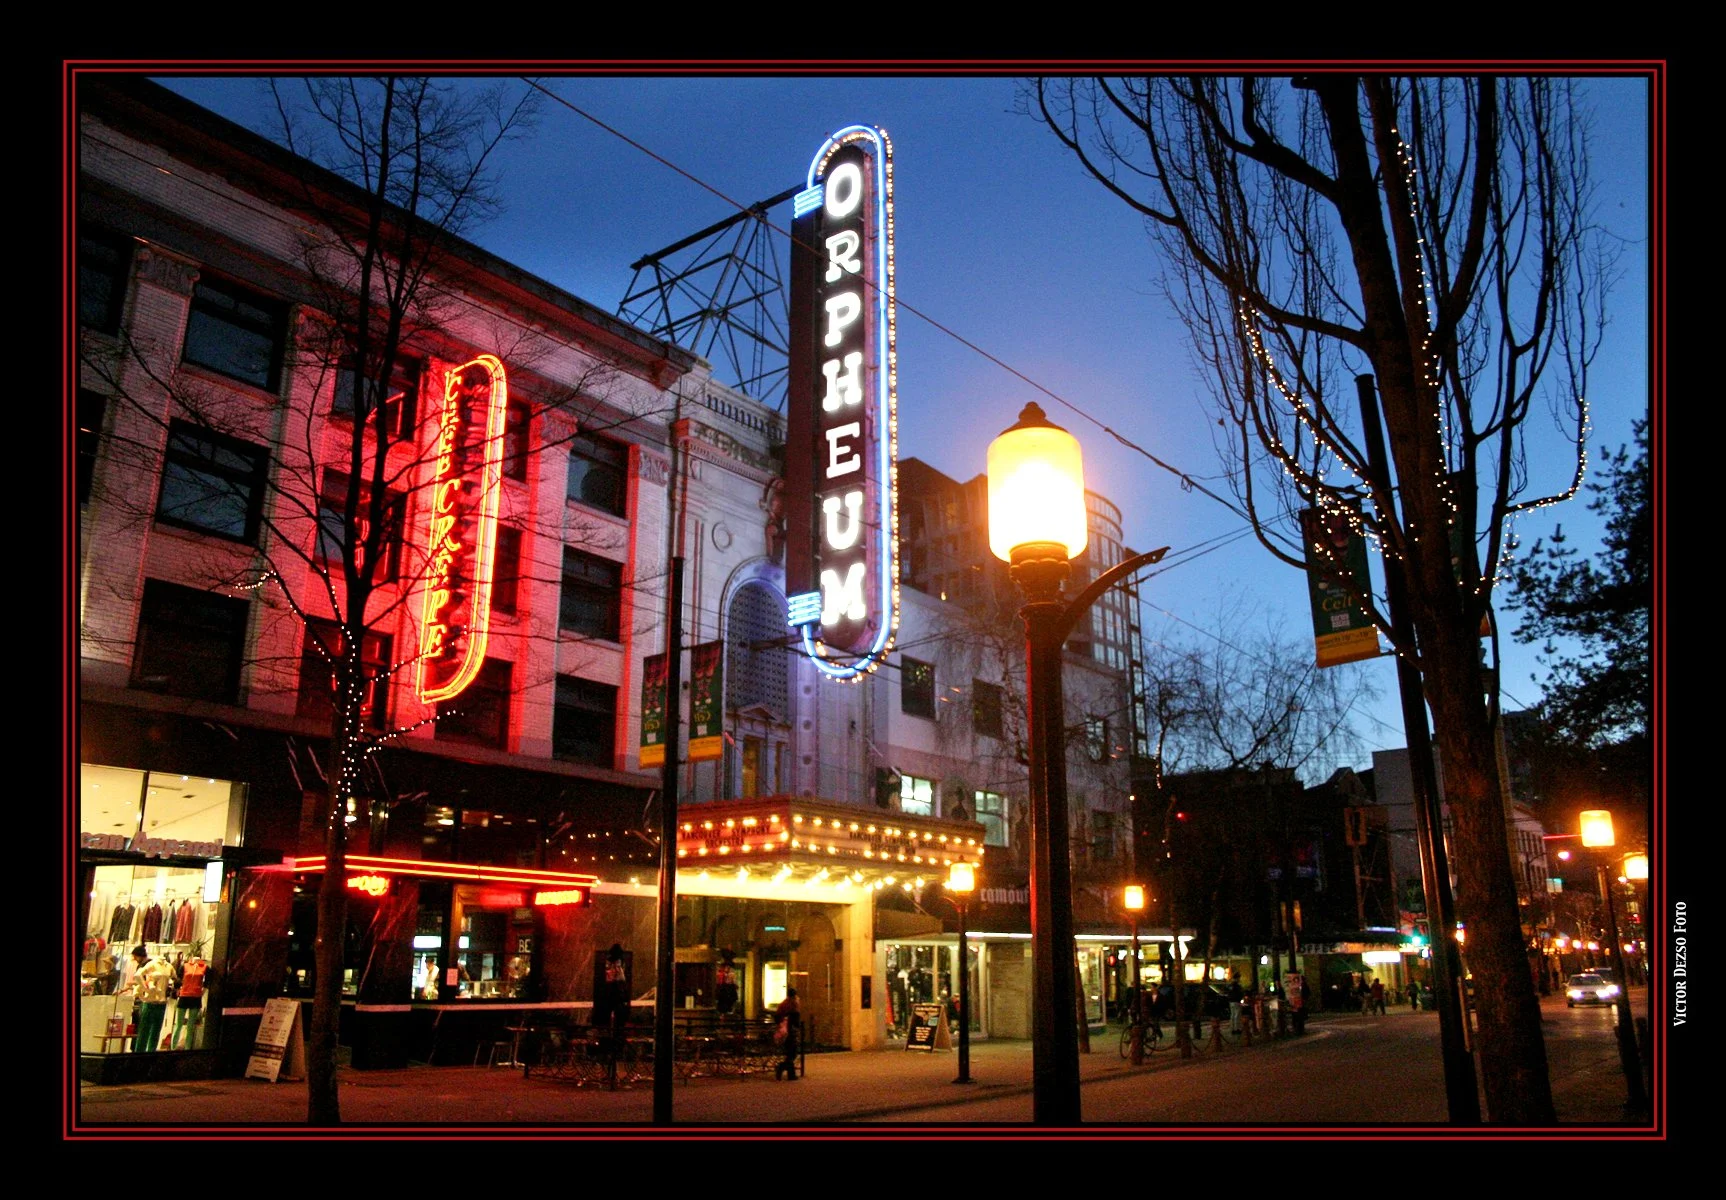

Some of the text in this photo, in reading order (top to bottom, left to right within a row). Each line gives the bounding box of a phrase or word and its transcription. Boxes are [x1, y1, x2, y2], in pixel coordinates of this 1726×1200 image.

[820, 162, 866, 626] ORPHEUM
[731, 825, 770, 836] SYMPHONY
[130, 831, 224, 859] Apparel
[704, 836, 745, 848] ORCHESTRA
